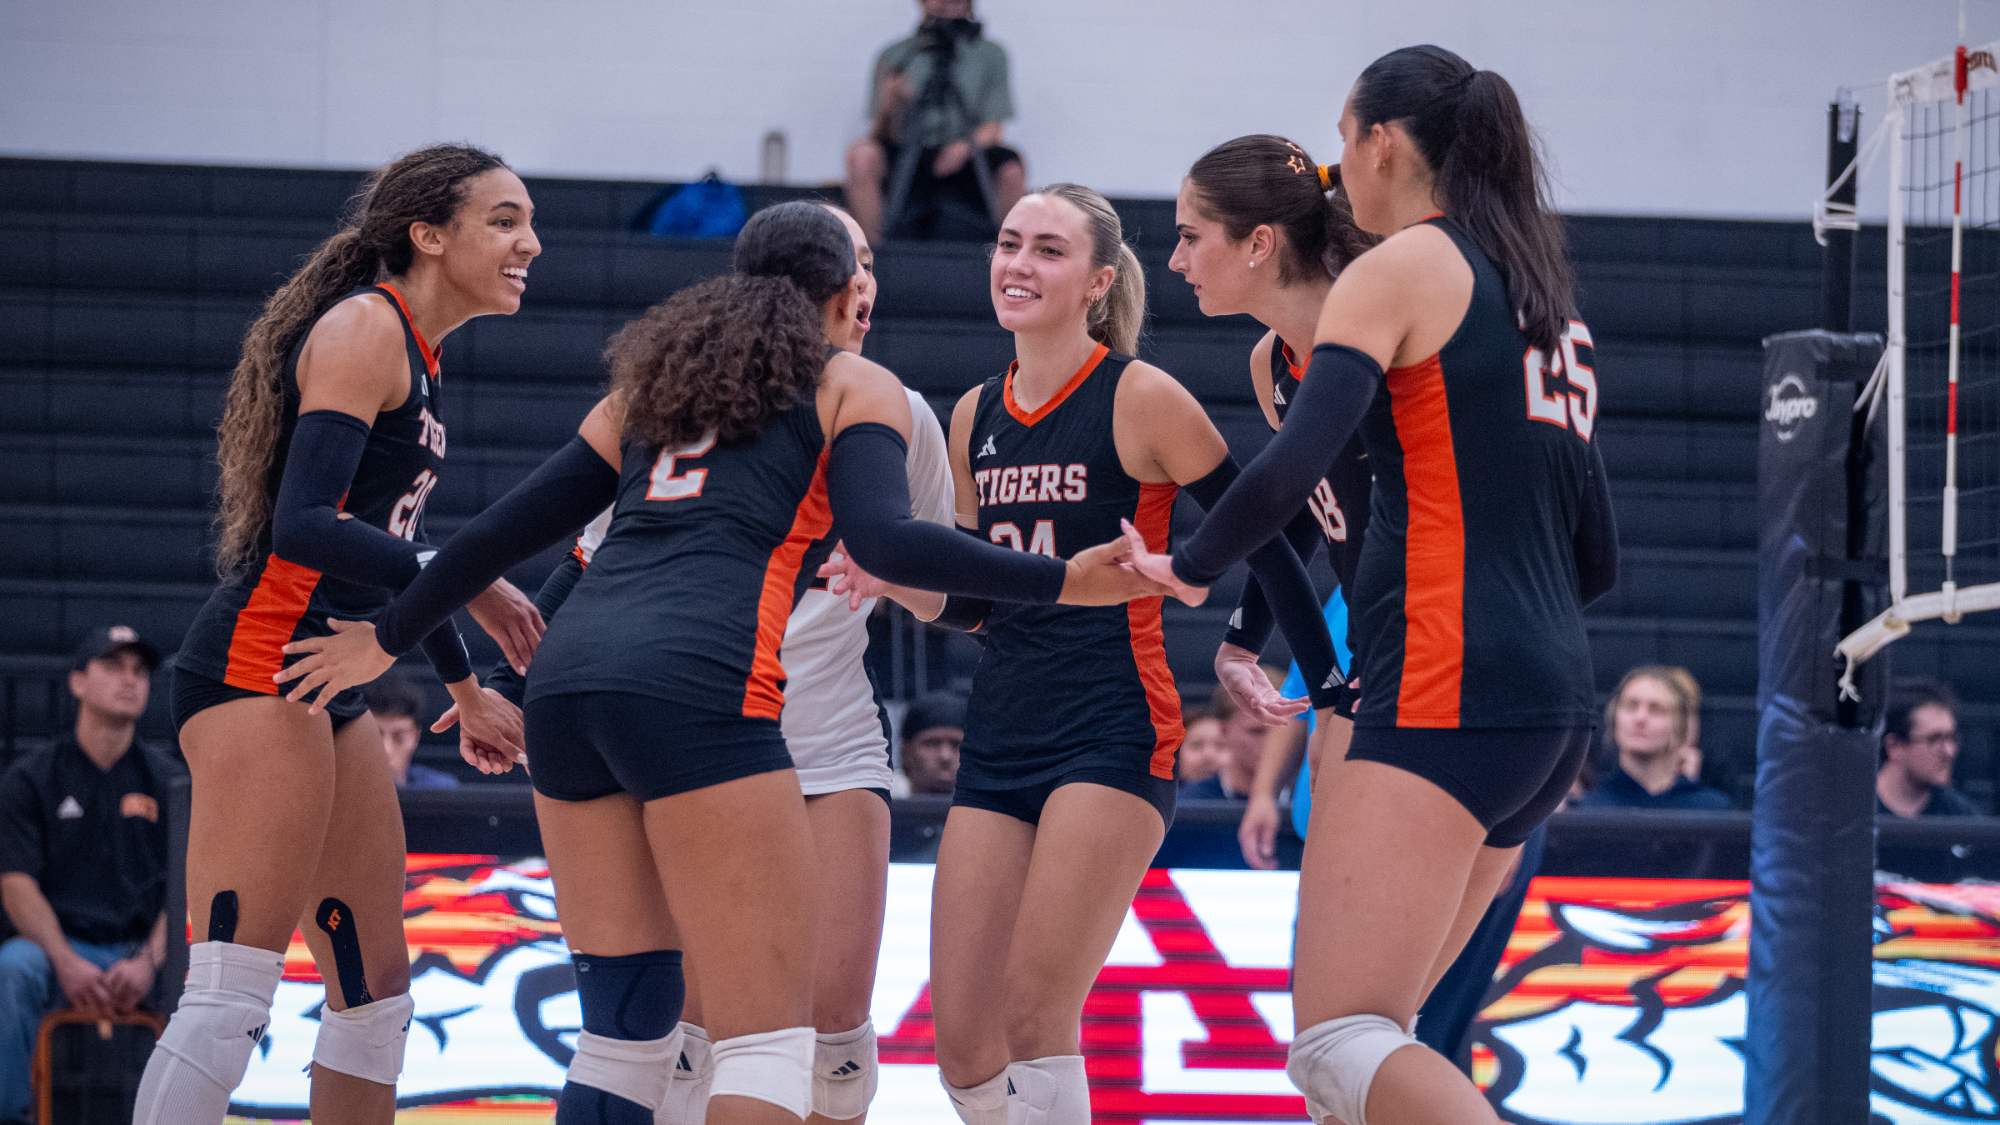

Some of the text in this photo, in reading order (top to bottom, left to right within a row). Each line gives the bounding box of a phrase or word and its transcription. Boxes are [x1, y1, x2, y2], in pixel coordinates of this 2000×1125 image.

[1518, 319, 1598, 443] 25
[644, 425, 718, 501] 2
[974, 463, 1088, 507] TIGERS
[387, 468, 438, 542] 20
[327, 908, 342, 931] KT
